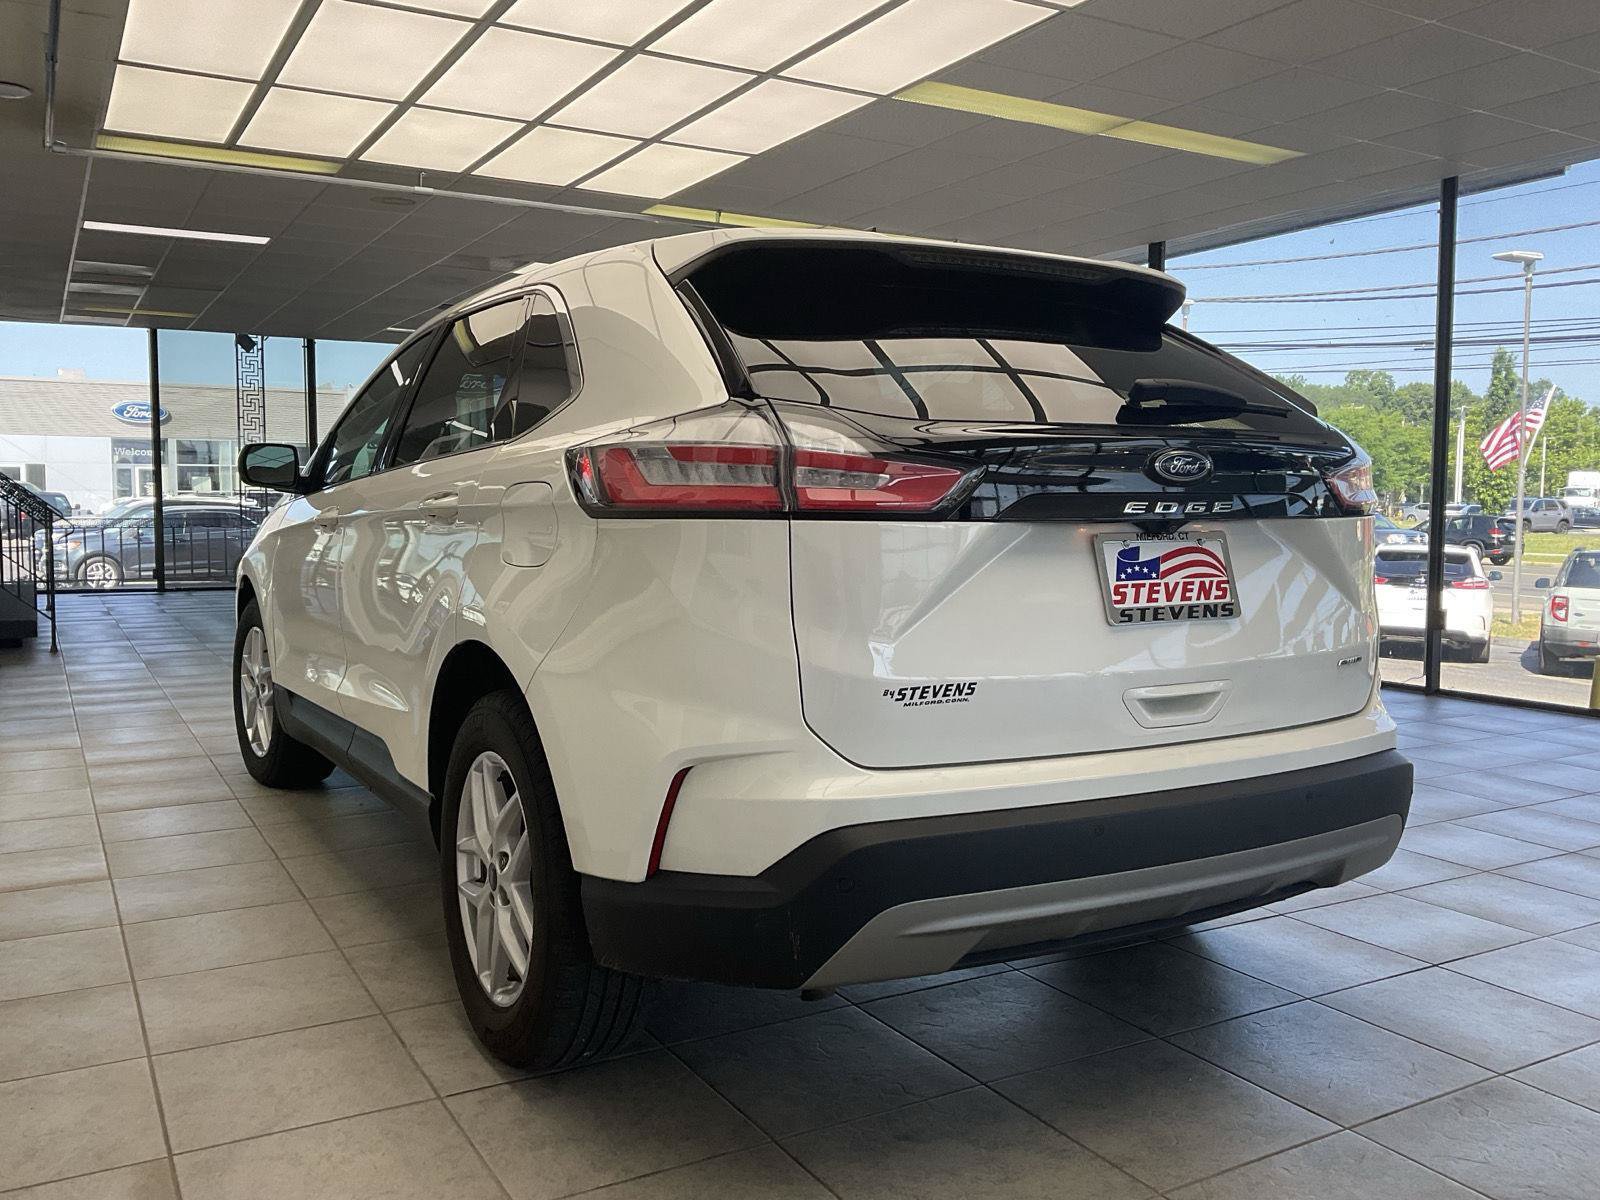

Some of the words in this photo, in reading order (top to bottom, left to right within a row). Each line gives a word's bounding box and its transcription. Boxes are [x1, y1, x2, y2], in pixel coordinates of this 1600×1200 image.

[1170, 456, 1201, 474] Ford
[1123, 501, 1234, 514] EDGE
[1178, 532, 1190, 540] CT
[1113, 580, 1230, 605] STEVENS
[1119, 602, 1235, 622] STEVENS
[895, 682, 977, 702] STEVENS
